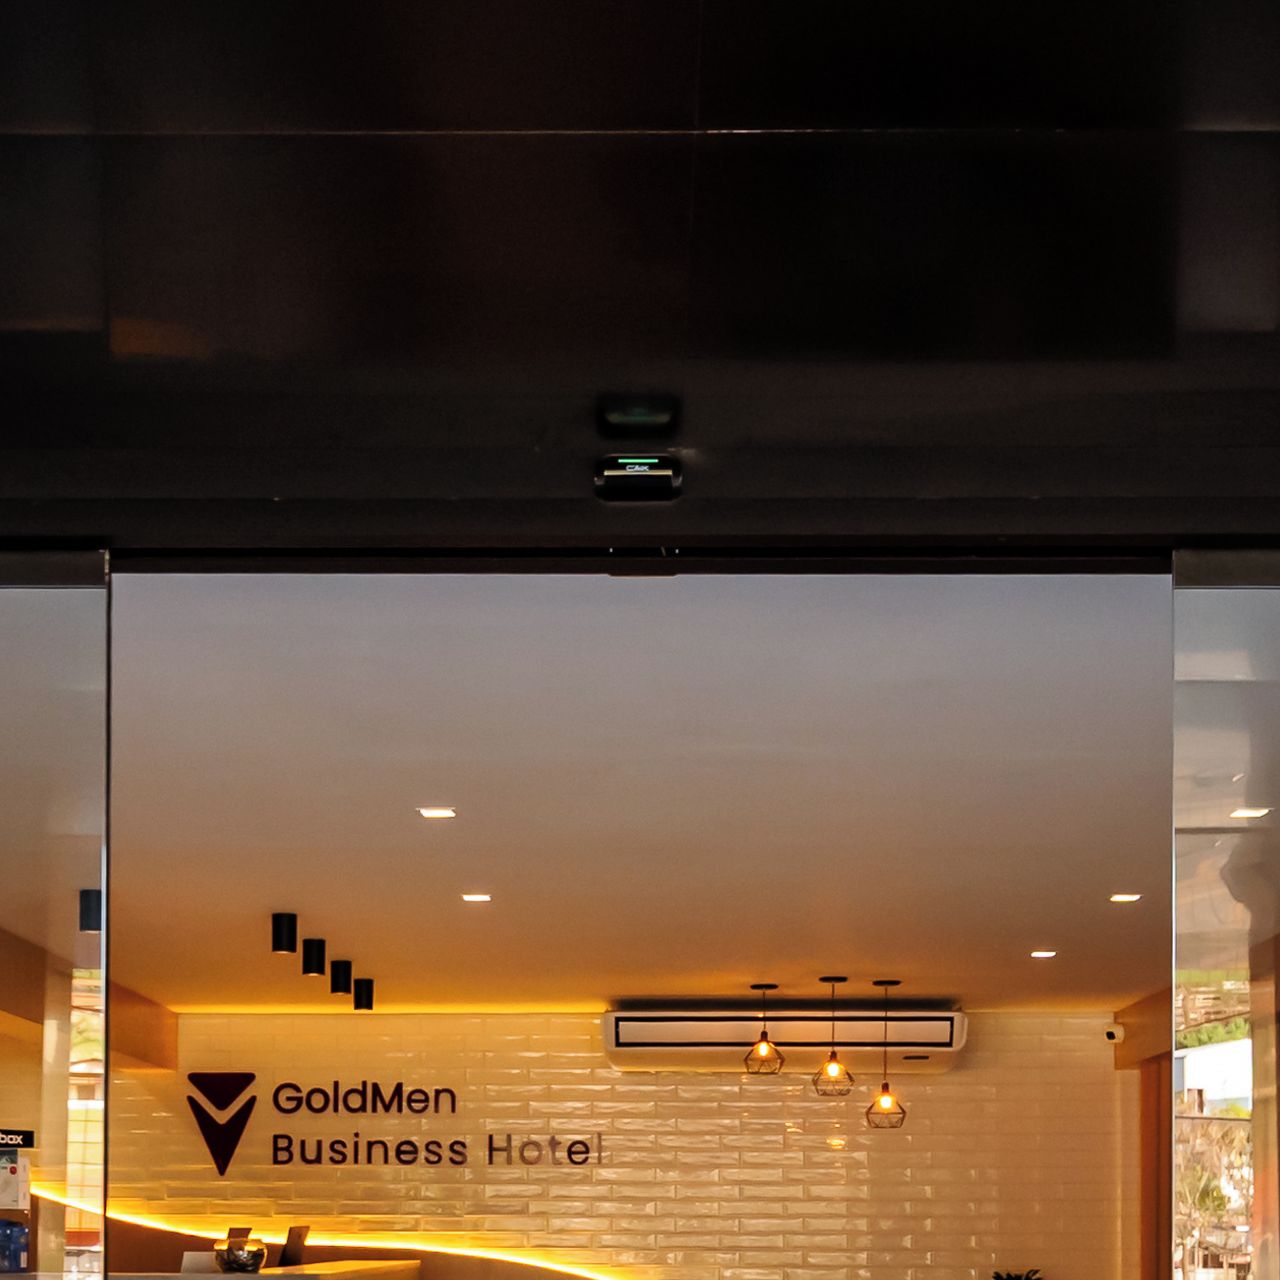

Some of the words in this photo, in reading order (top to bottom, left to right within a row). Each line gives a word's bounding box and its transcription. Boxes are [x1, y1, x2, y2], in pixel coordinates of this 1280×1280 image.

[272, 1080, 457, 1115] GoldMen
[272, 1132, 468, 1166] Business
[487, 1133, 603, 1166] Hotel
